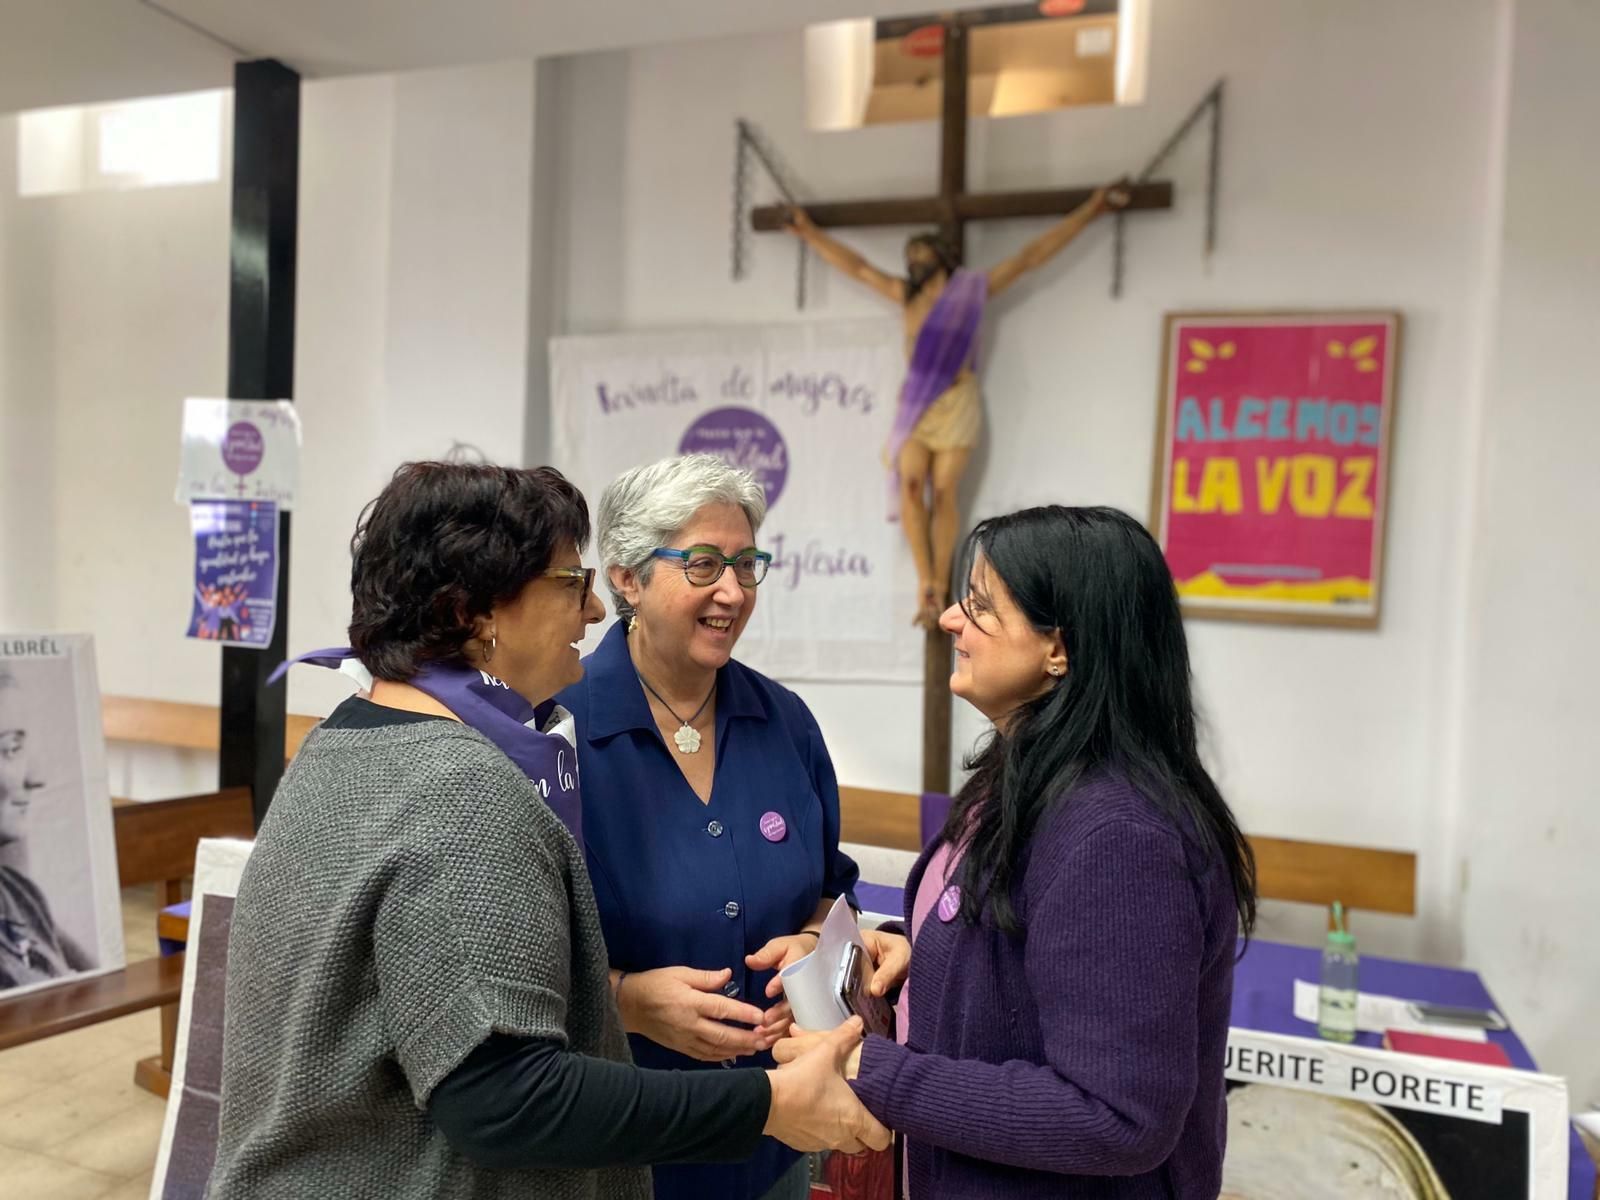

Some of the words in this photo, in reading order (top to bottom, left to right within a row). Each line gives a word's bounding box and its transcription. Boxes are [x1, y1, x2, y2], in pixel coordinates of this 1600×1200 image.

[1172, 456, 1243, 515] LA
[1255, 453, 1376, 520] VOZ
[0, 634, 61, 656] LBRÊL
[530, 778, 551, 798] n
[557, 750, 575, 793] la
[1351, 1066, 1485, 1113] PORETE
